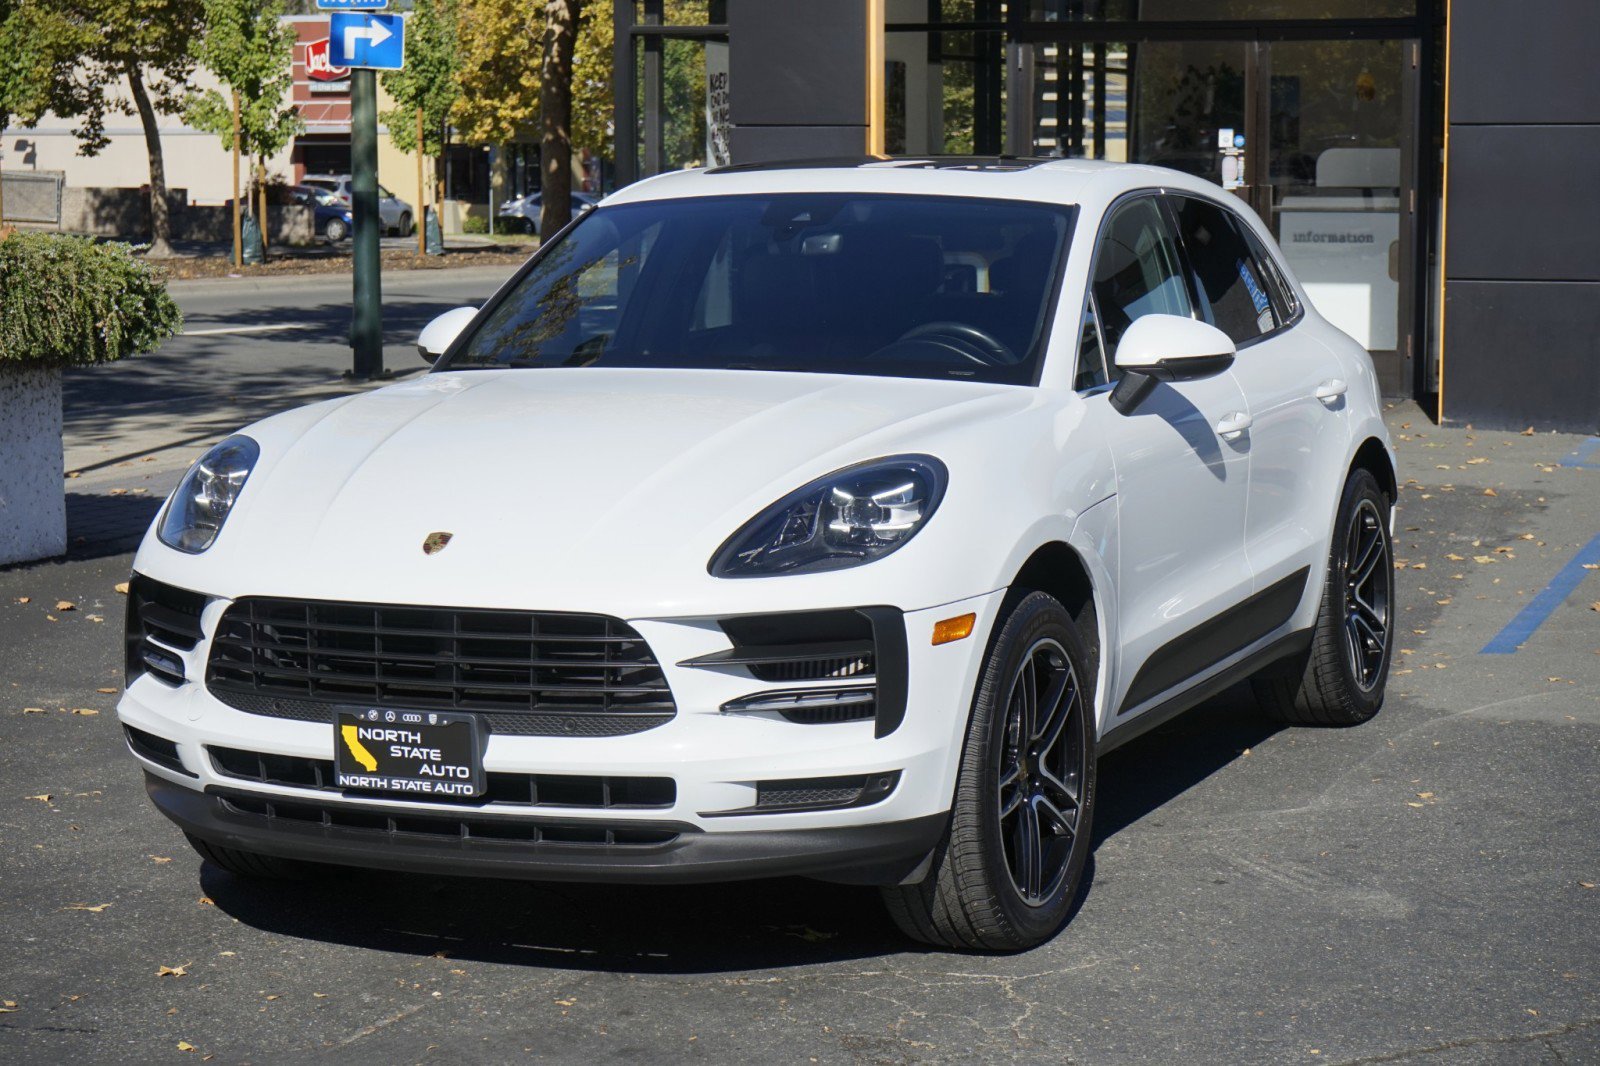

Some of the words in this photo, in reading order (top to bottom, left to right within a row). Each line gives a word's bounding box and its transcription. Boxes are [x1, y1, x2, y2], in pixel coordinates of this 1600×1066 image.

[1293, 231, 1374, 243] information
[359, 727, 421, 744] NORTH
[390, 745, 442, 761] STATE
[419, 763, 470, 778] AUTO
[339, 775, 388, 789] NORTH
[391, 779, 432, 792] STATE
[434, 783, 474, 795] AUTO
